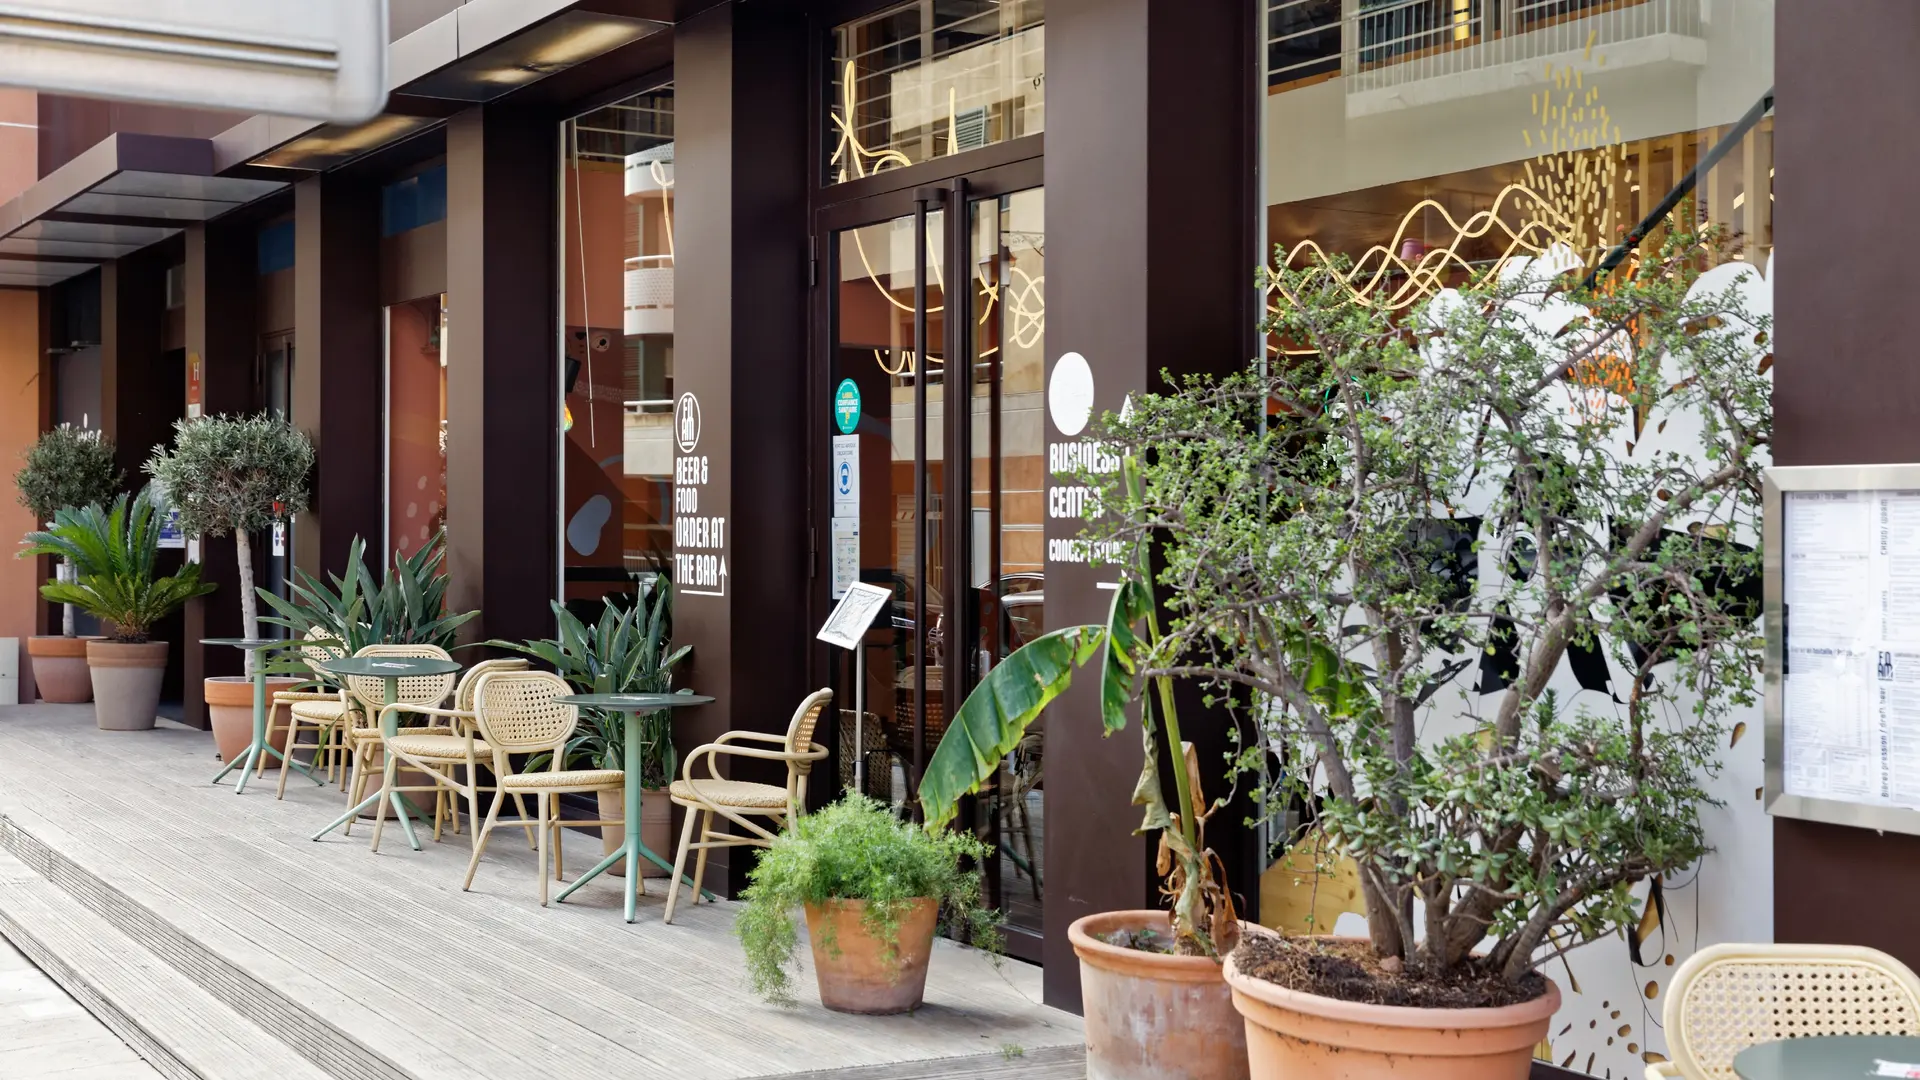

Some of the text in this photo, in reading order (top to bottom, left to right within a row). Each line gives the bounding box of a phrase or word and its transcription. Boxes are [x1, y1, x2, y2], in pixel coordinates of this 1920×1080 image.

[193, 362, 200, 381] H
[676, 455, 708, 485] BEER &
[1049, 441, 1121, 474] BUSINESS
[676, 487, 698, 514] FOOD
[676, 516, 725, 549] ORDER AT
[675, 553, 718, 587] THE BAR
